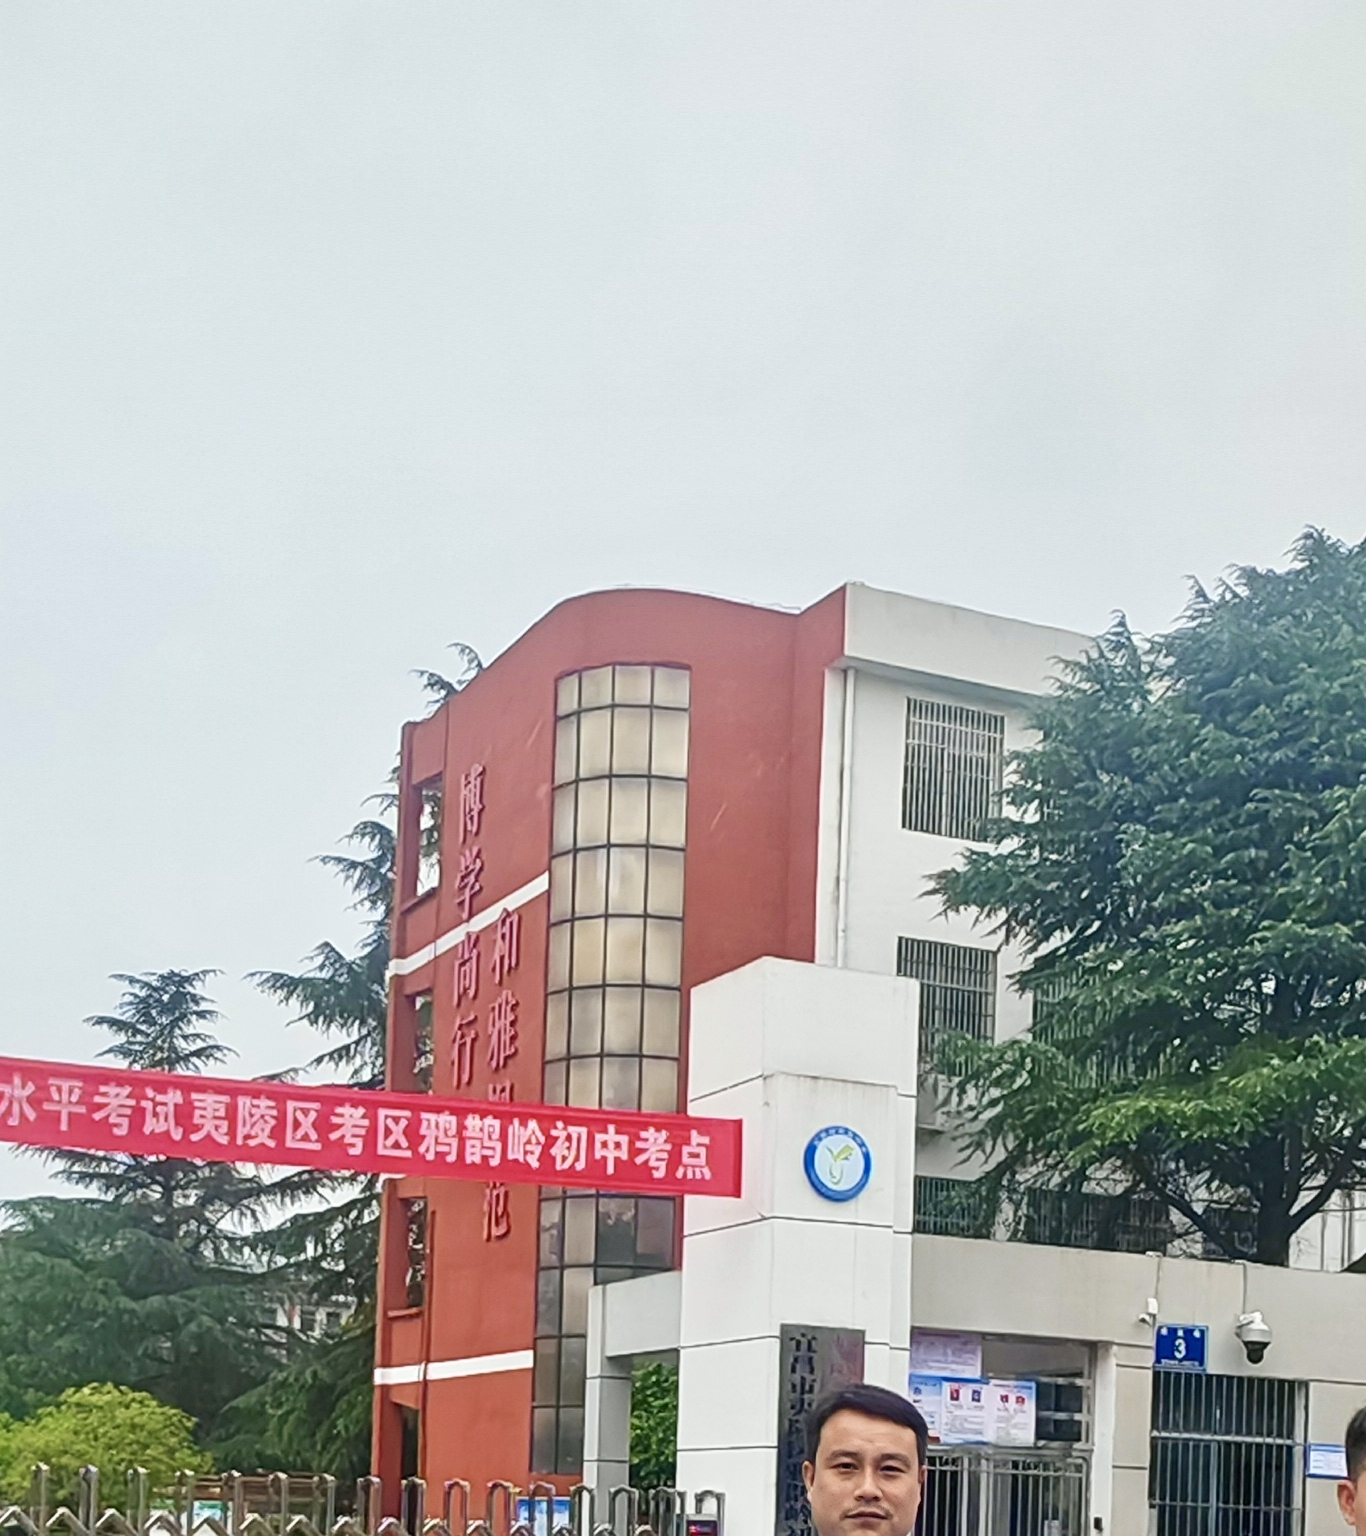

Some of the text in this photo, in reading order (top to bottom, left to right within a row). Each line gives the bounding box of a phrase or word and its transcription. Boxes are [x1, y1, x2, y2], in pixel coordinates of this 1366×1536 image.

[451, 763, 485, 1088] 博学尚行
[1174, 1338, 1186, 1360] 3
